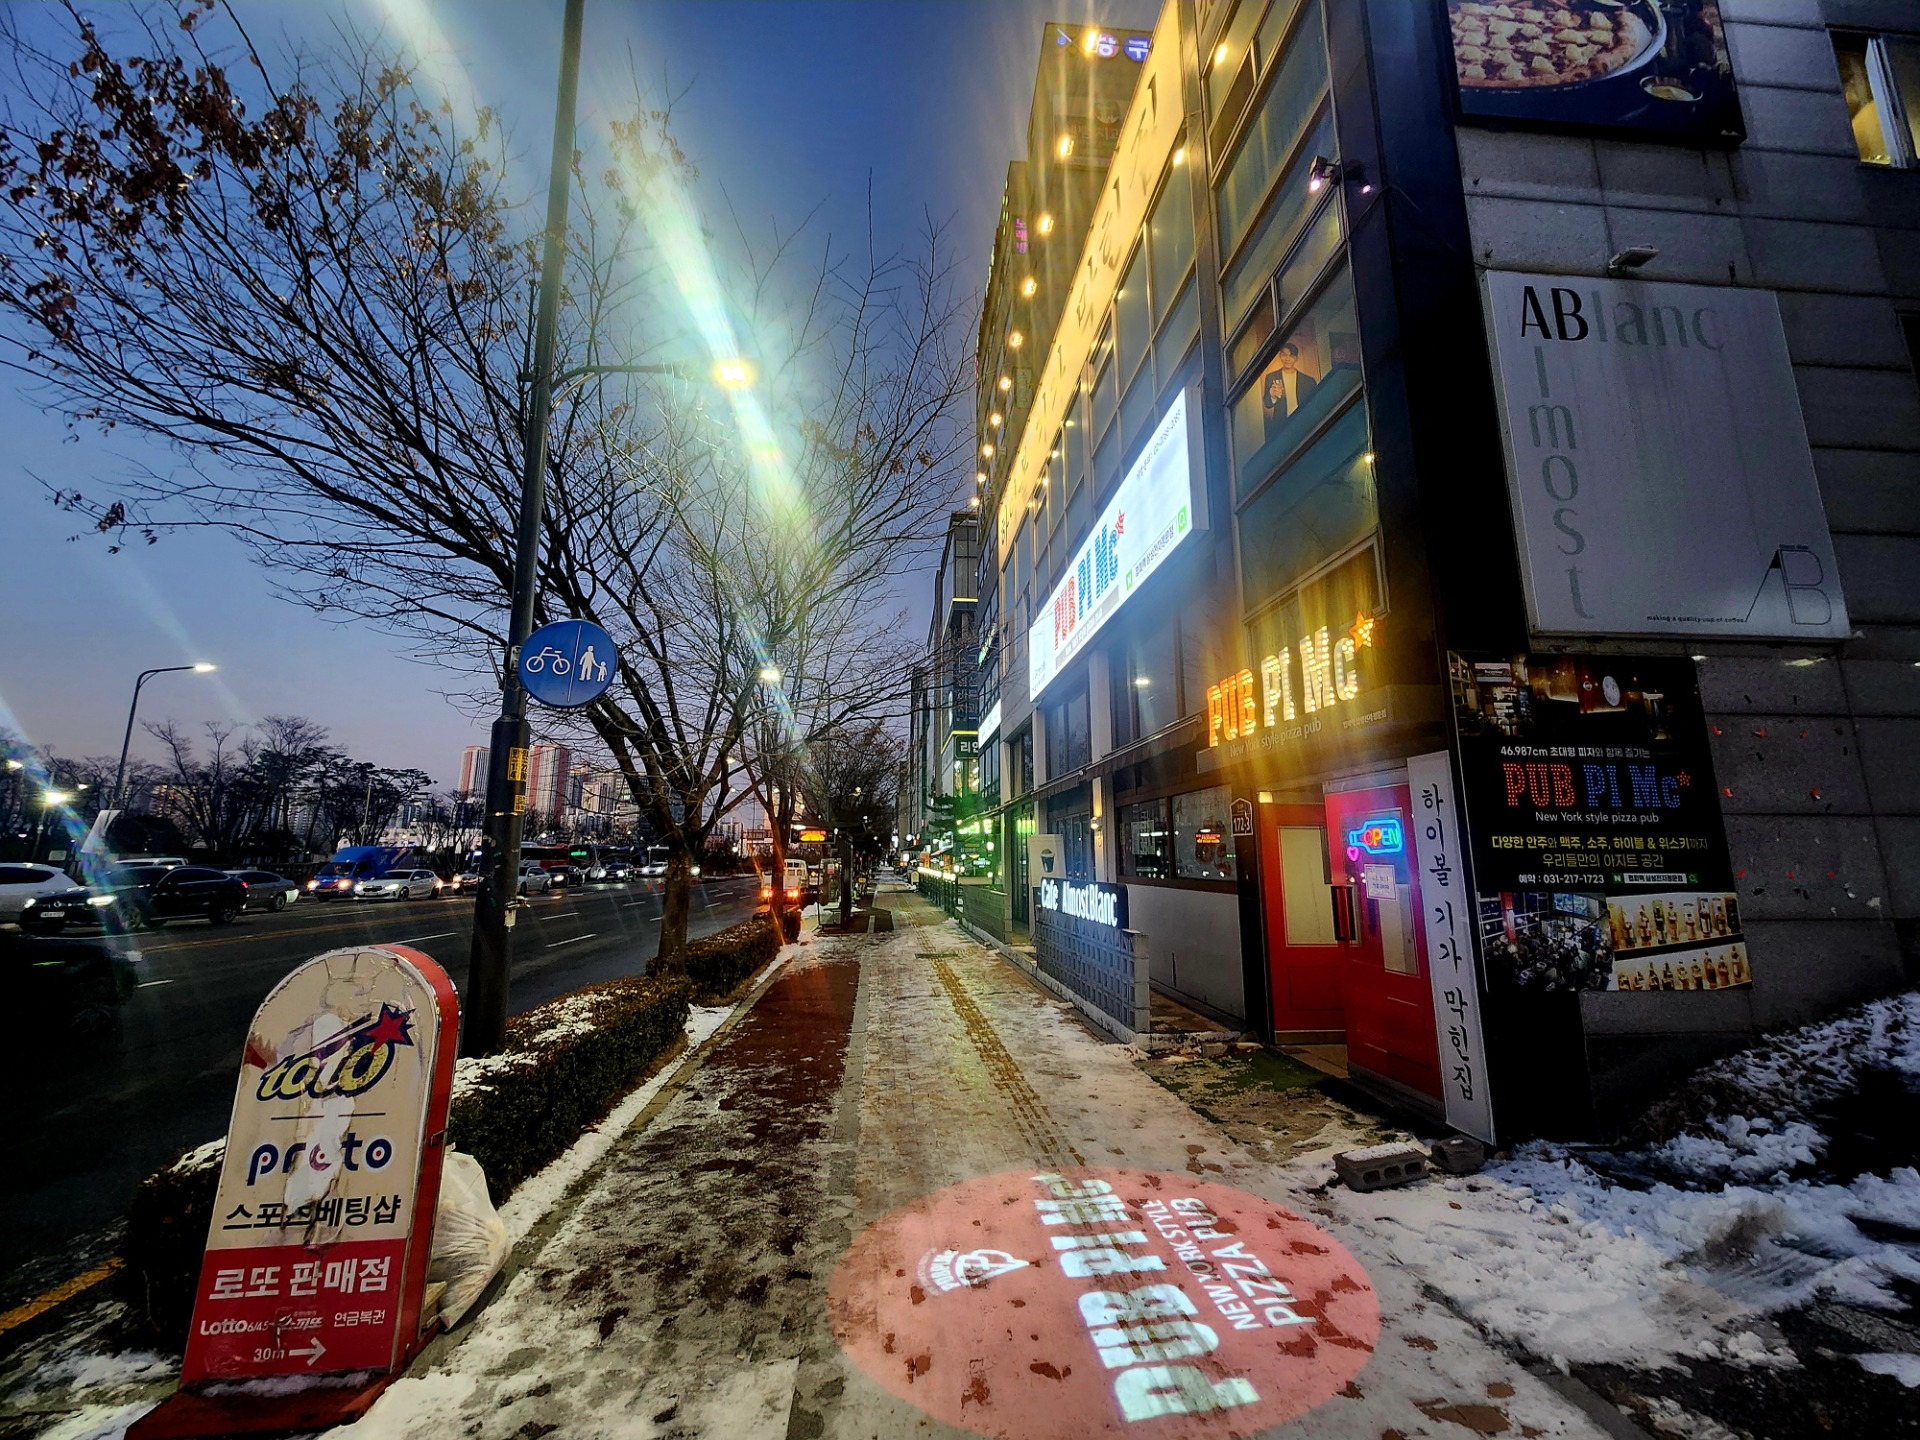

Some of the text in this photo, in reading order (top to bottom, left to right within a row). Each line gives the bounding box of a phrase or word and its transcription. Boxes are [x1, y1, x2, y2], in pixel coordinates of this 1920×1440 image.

[1054, 575, 1076, 651] PUB
[1077, 548, 1093, 620] PI
[1207, 667, 1257, 748] PUB
[1261, 646, 1296, 728] PI
[1261, 730, 1280, 749] style
[1280, 724, 1303, 744] pizza
[1304, 717, 1322, 740] pub
[1500, 746, 1548, 757] 46.987cm
[1550, 746, 1576, 758] 초대형
[1578, 747, 1604, 758] 피자와
[1502, 762, 1576, 808] PUB
[1583, 763, 1622, 808] PI
[1364, 827, 1399, 846] OPEN
[1421, 783, 1452, 888] 하이볼
[1535, 811, 1660, 824] New York style pizza pub
[1492, 836, 1709, 850] 다양한 안주와 맥주, 소주, 하이볼 & 위스키까지
[1542, 853, 1665, 868] 우리들만의 아지트 공간
[1543, 873, 1605, 884] 031-217-1723
[1041, 878, 1118, 927] Cafe AlmostBlanc
[1434, 899, 1463, 974] 기가
[255, 1038, 395, 1101] toto
[208, 1255, 392, 1300] 로또 판매점
[1050, 1230, 1168, 1279] PI
[1142, 1199, 1264, 1331] NEW YORK STYLE
[1170, 1197, 1317, 1327] PIZZA PUB
[333, 1308, 386, 1328] 연금복권
[253, 1347, 286, 1361] 30m
[1077, 1282, 1262, 1424] PUB
